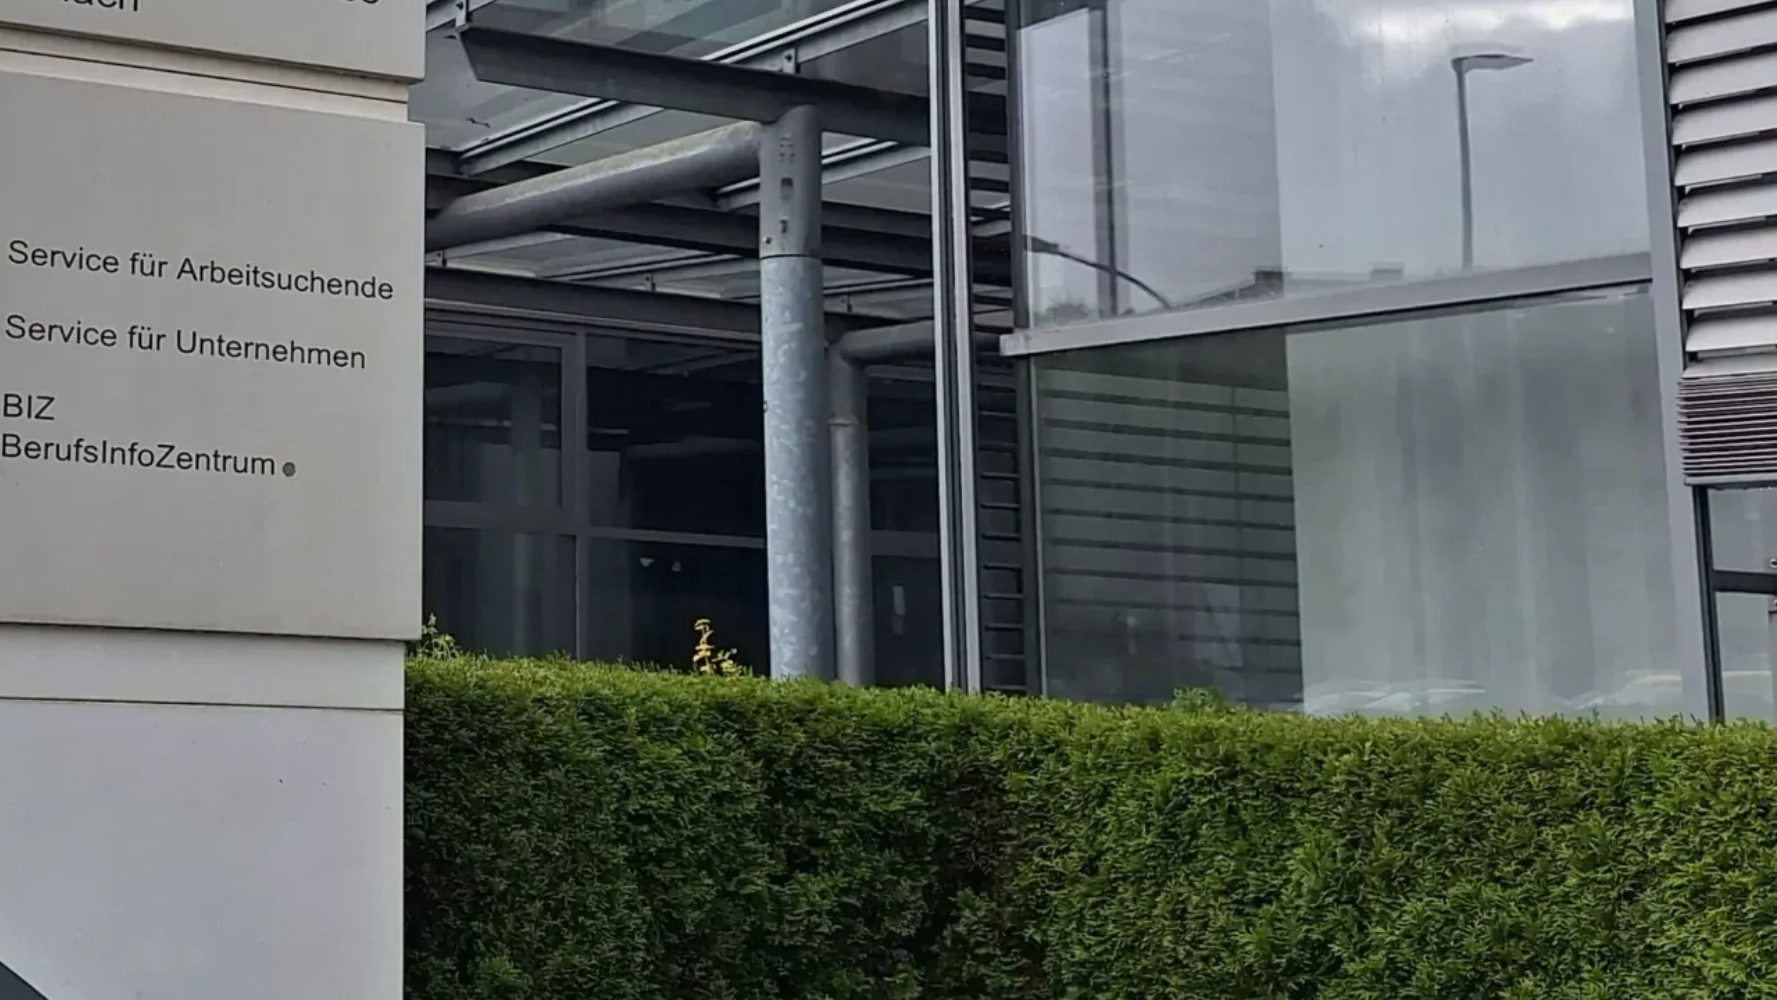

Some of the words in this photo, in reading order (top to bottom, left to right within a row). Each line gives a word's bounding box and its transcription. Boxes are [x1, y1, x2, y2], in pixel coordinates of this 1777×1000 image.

[8, 239, 120, 274] Service
[130, 252, 169, 278] für
[176, 257, 394, 300] Arbeitsuchende
[5, 314, 118, 347] Service
[127, 325, 167, 352] für
[176, 330, 366, 370] Unternehmen
[2, 393, 56, 421] BIZ
[1, 433, 275, 477] BerufsInfoZentrum
